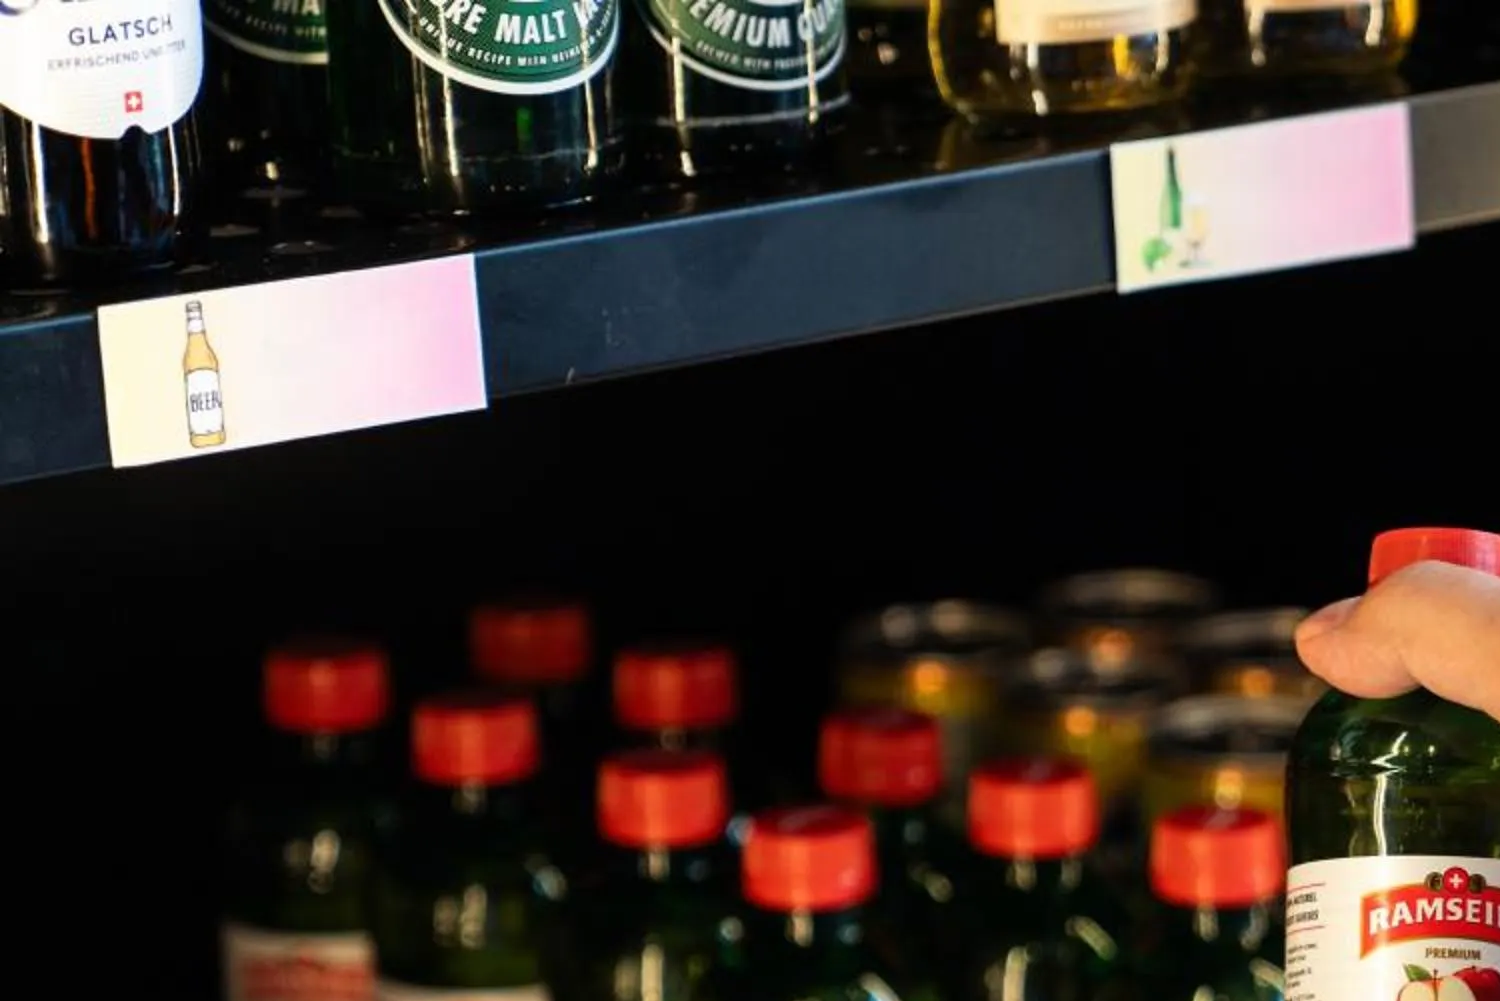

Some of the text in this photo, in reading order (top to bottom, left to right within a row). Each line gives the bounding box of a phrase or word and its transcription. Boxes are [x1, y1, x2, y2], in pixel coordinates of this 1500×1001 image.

[68, 14, 173, 46] GLATSCH
[494, 9, 567, 44] MALT
[681, 0, 791, 48] EMIUM
[468, 47, 511, 66] RECIPE
[190, 390, 223, 413] BEER
[1425, 947, 1482, 961] PREMIUM
